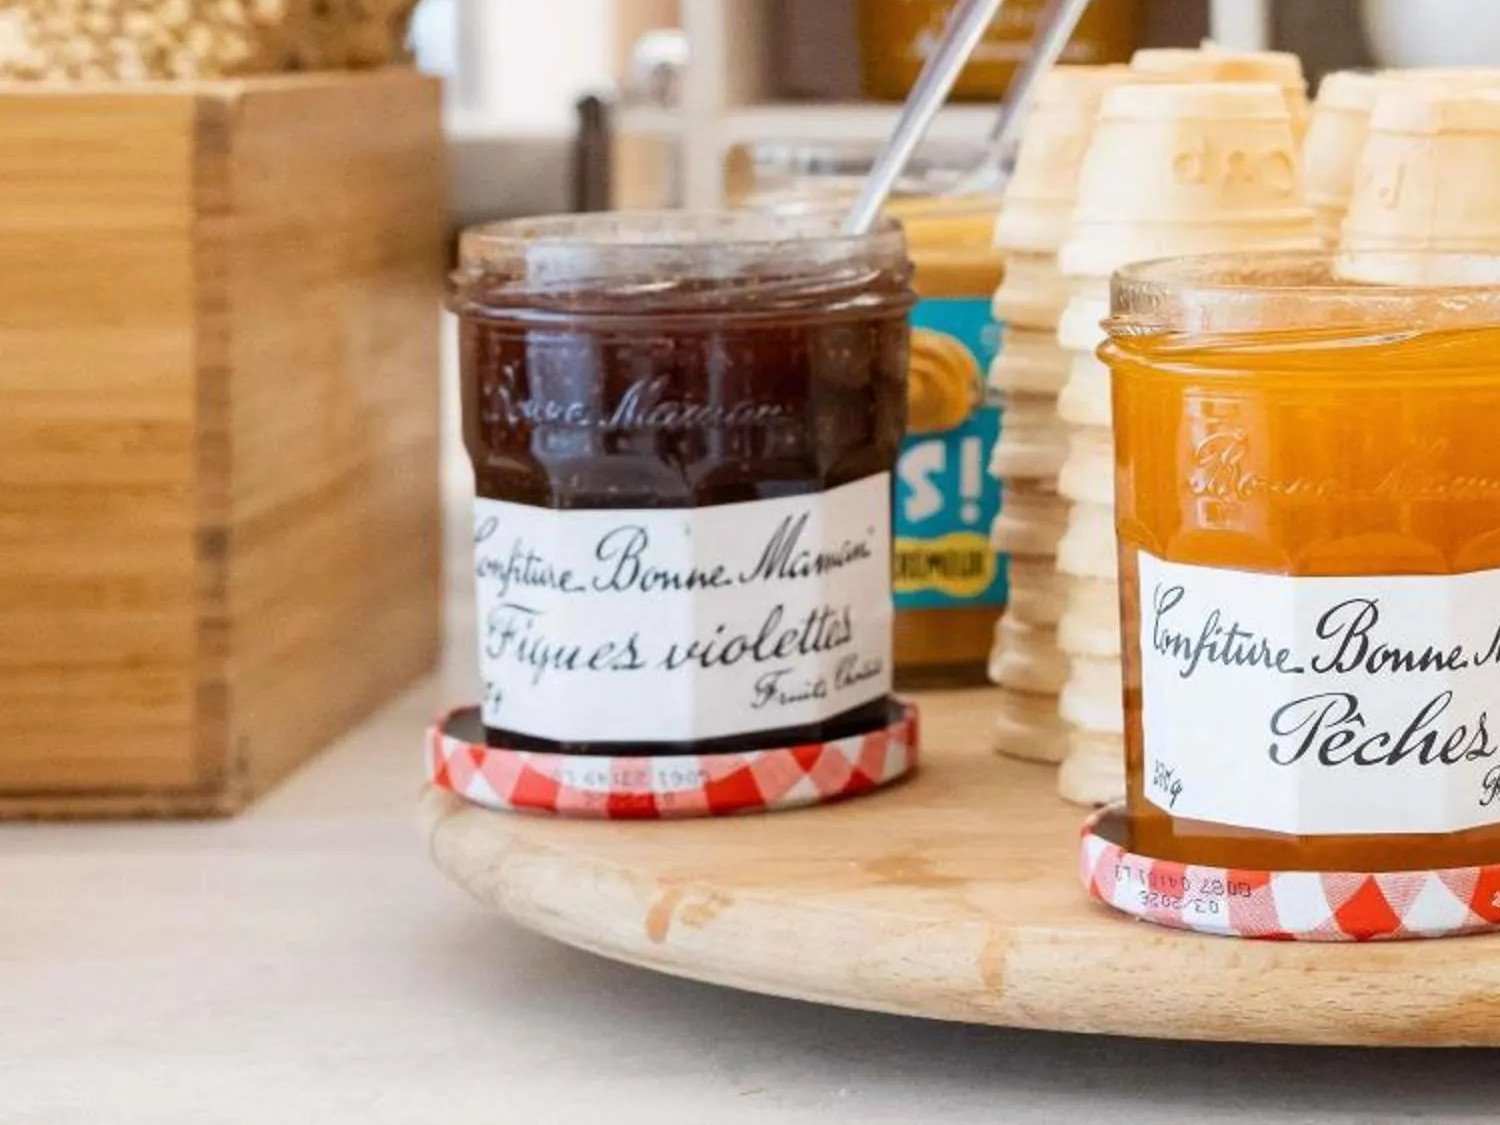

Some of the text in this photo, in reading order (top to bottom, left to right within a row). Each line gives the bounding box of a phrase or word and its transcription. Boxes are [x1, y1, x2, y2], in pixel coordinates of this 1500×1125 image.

[592, 524, 732, 592] Bonne
[738, 510, 872, 582] Maman
[486, 602, 853, 685] Figues violettes
[1153, 583, 1304, 679] Confiture
[1311, 597, 1468, 674] Bonne
[750, 668, 828, 709] Fruits
[1268, 690, 1498, 767] Pêches
